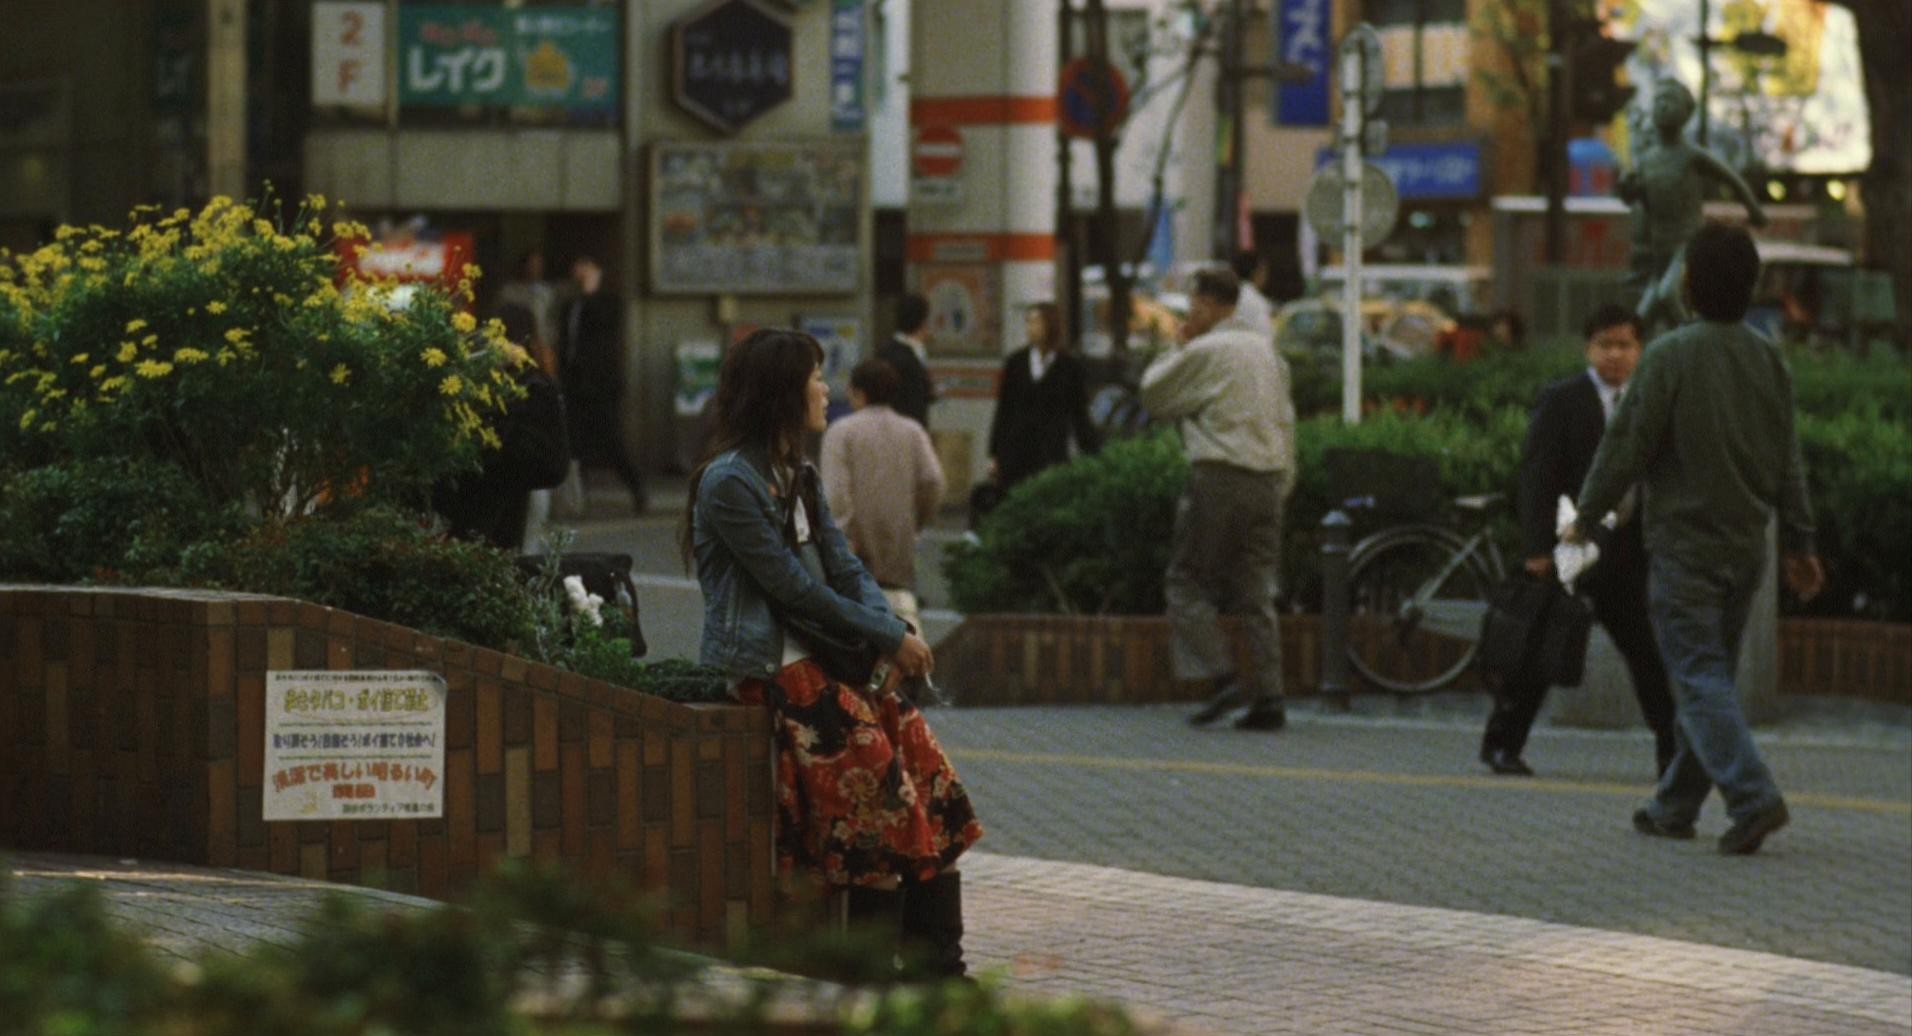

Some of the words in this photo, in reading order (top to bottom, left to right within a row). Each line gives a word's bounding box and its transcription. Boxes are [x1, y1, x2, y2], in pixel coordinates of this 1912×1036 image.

[337, 9, 366, 96] 2F
[407, 44, 507, 93] レイク
